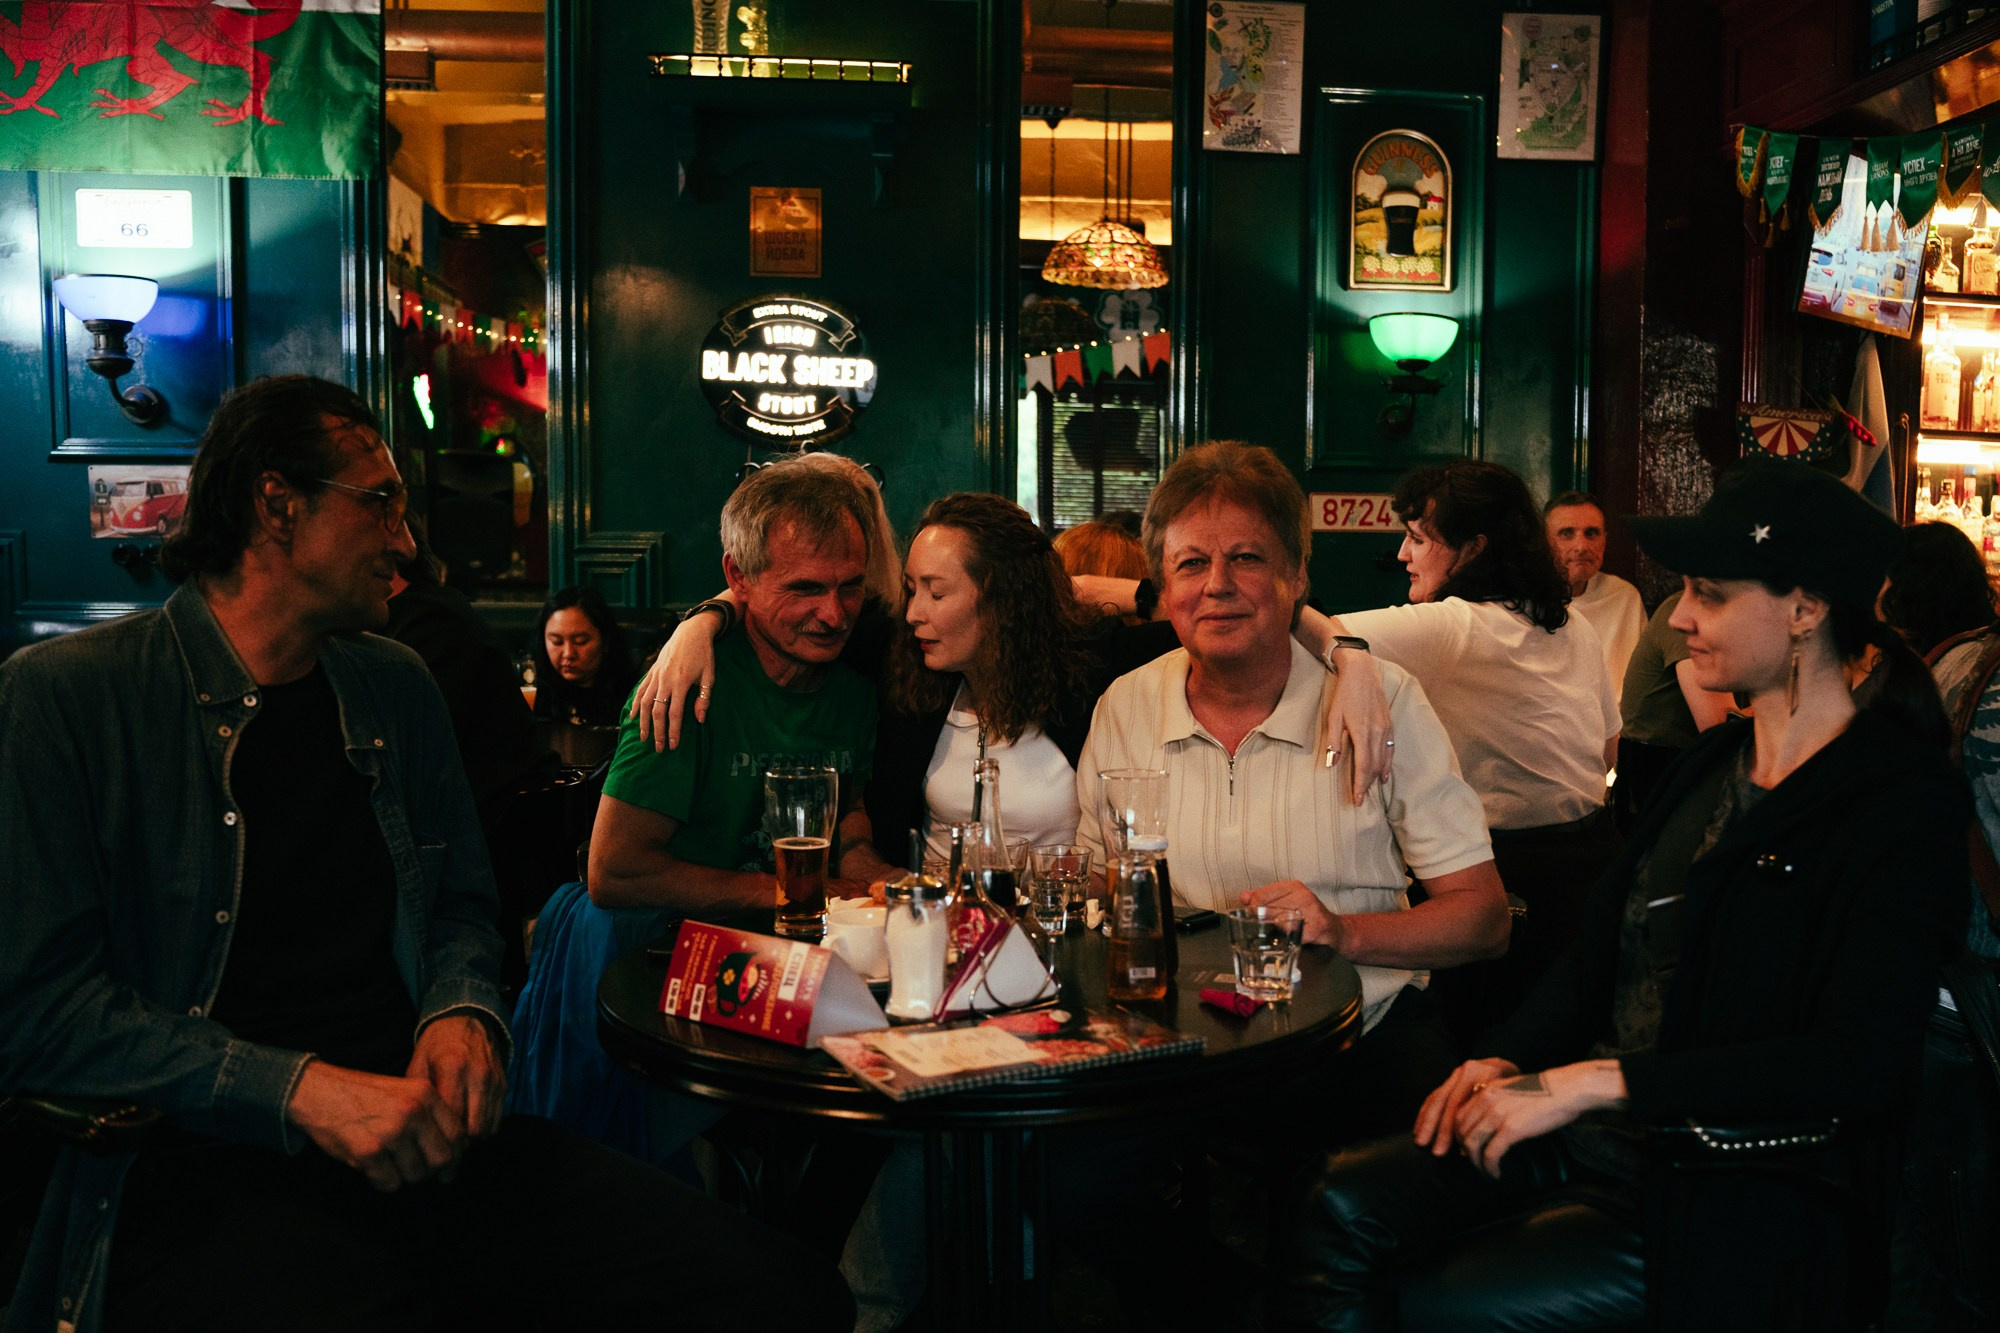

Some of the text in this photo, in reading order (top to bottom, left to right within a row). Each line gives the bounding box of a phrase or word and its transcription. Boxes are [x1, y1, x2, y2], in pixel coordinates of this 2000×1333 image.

[1362, 140, 1438, 178] GUINNESS
[1903, 157, 1925, 175] УСПЕХ
[121, 223, 149, 237] 66
[752, 304, 828, 322] EXTRA STOUT
[763, 325, 817, 347] IRISH
[702, 350, 875, 388] BLACK SHEEP
[757, 393, 817, 415] STOUT
[1323, 499, 1392, 526] 8724
[783, 952, 803, 987] СПЕЦ
